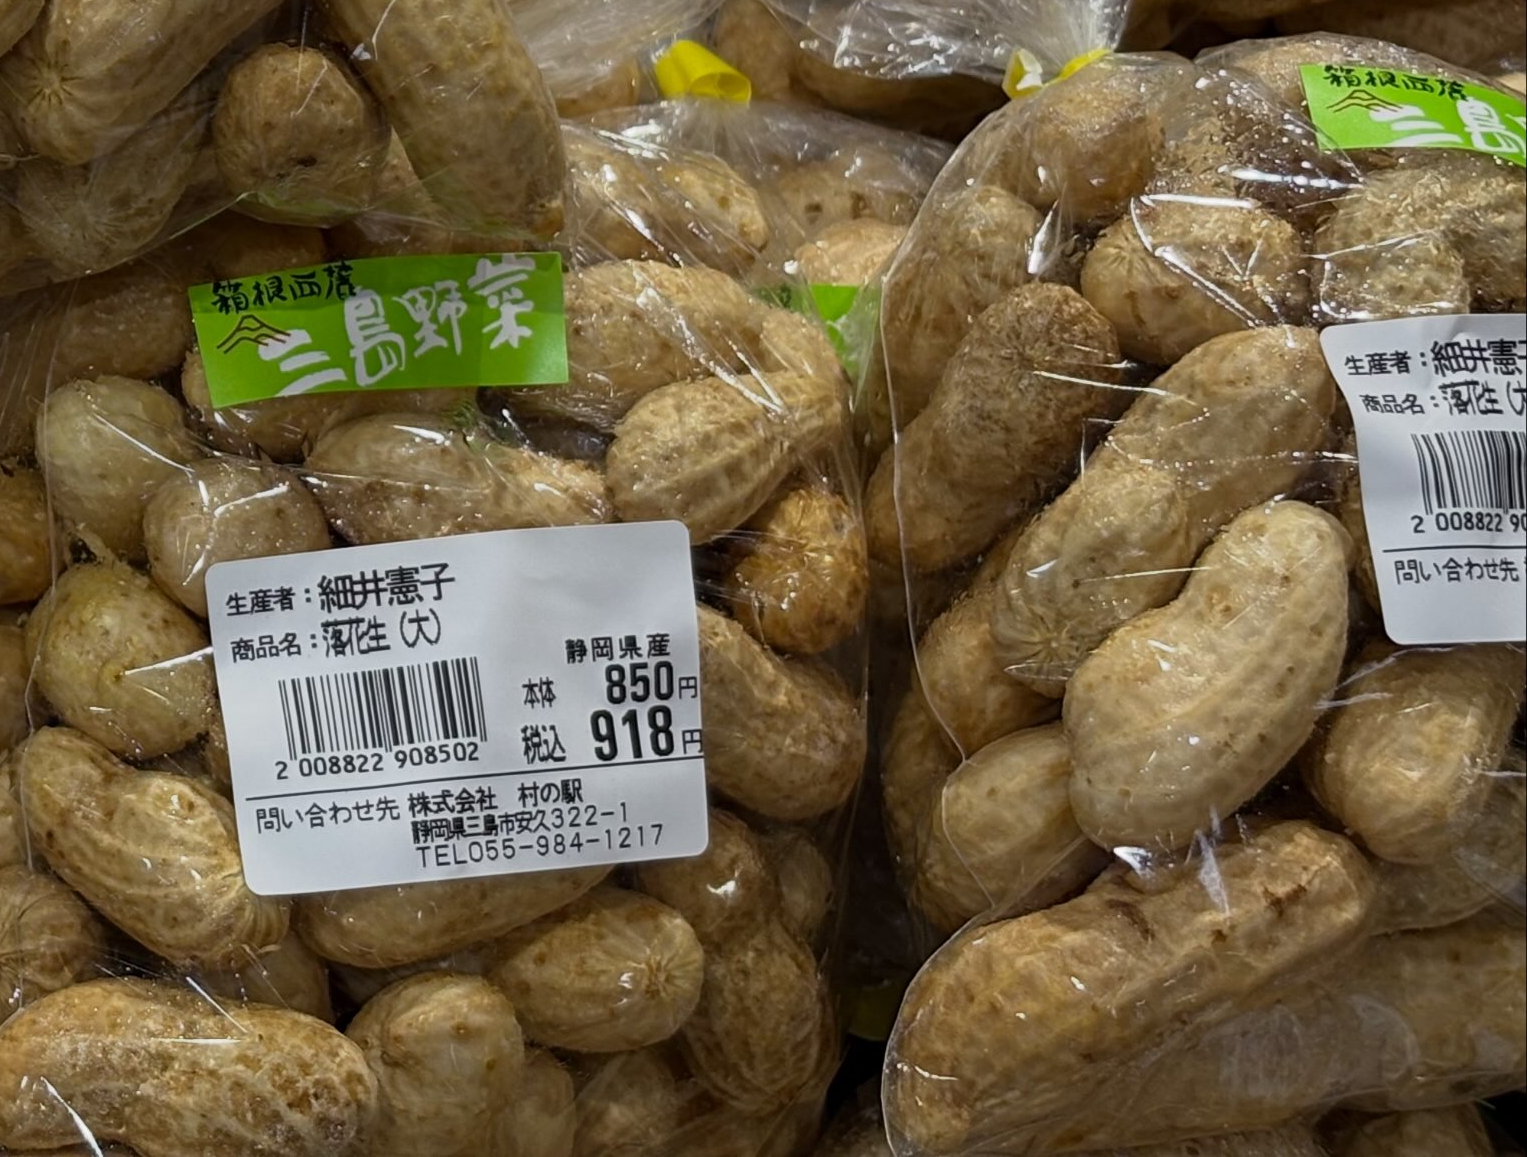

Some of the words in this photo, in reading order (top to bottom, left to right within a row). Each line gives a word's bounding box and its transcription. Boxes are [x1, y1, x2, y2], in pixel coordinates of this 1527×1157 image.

[1369, 96, 1526, 159] 三島
[258, 254, 536, 397] 三島野菜
[1411, 515, 1424, 533] 2
[1436, 512, 1503, 532] 008822
[1394, 556, 1519, 585] 問い合わせ先
[565, 633, 671, 664] 静岡県産
[522, 677, 556, 710] 本体
[605, 660, 699, 705] 850円
[521, 725, 567, 765] 税込
[590, 705, 703, 762] 918円
[275, 761, 288, 781] 2
[299, 752, 384, 778] 008822
[394, 743, 480, 770] 908502
[256, 796, 401, 834] 問い合わせ先
[407, 787, 499, 816] 株式会社
[518, 778, 583, 807] 村の駅
[416, 824, 664, 868] TEL055-984-1217
